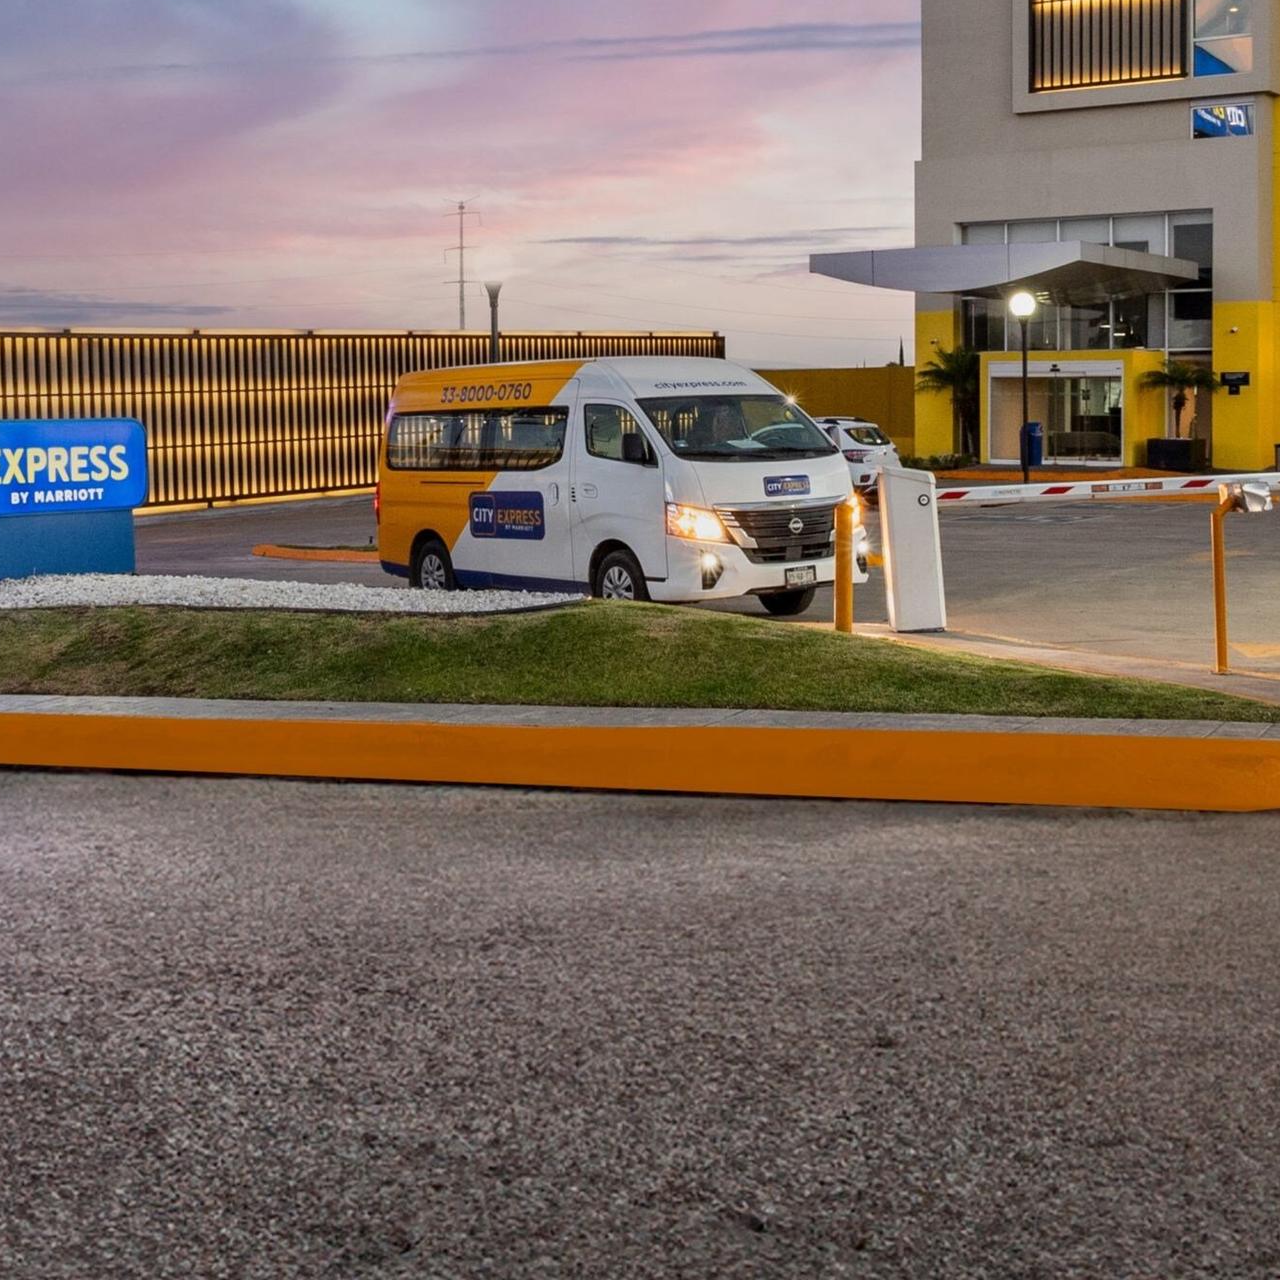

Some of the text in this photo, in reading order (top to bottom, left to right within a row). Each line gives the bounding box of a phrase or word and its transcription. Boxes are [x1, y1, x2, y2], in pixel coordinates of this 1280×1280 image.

[10, 488, 105, 505] BY MARRIOTT
[473, 507, 541, 525] CITY EXPRESS
